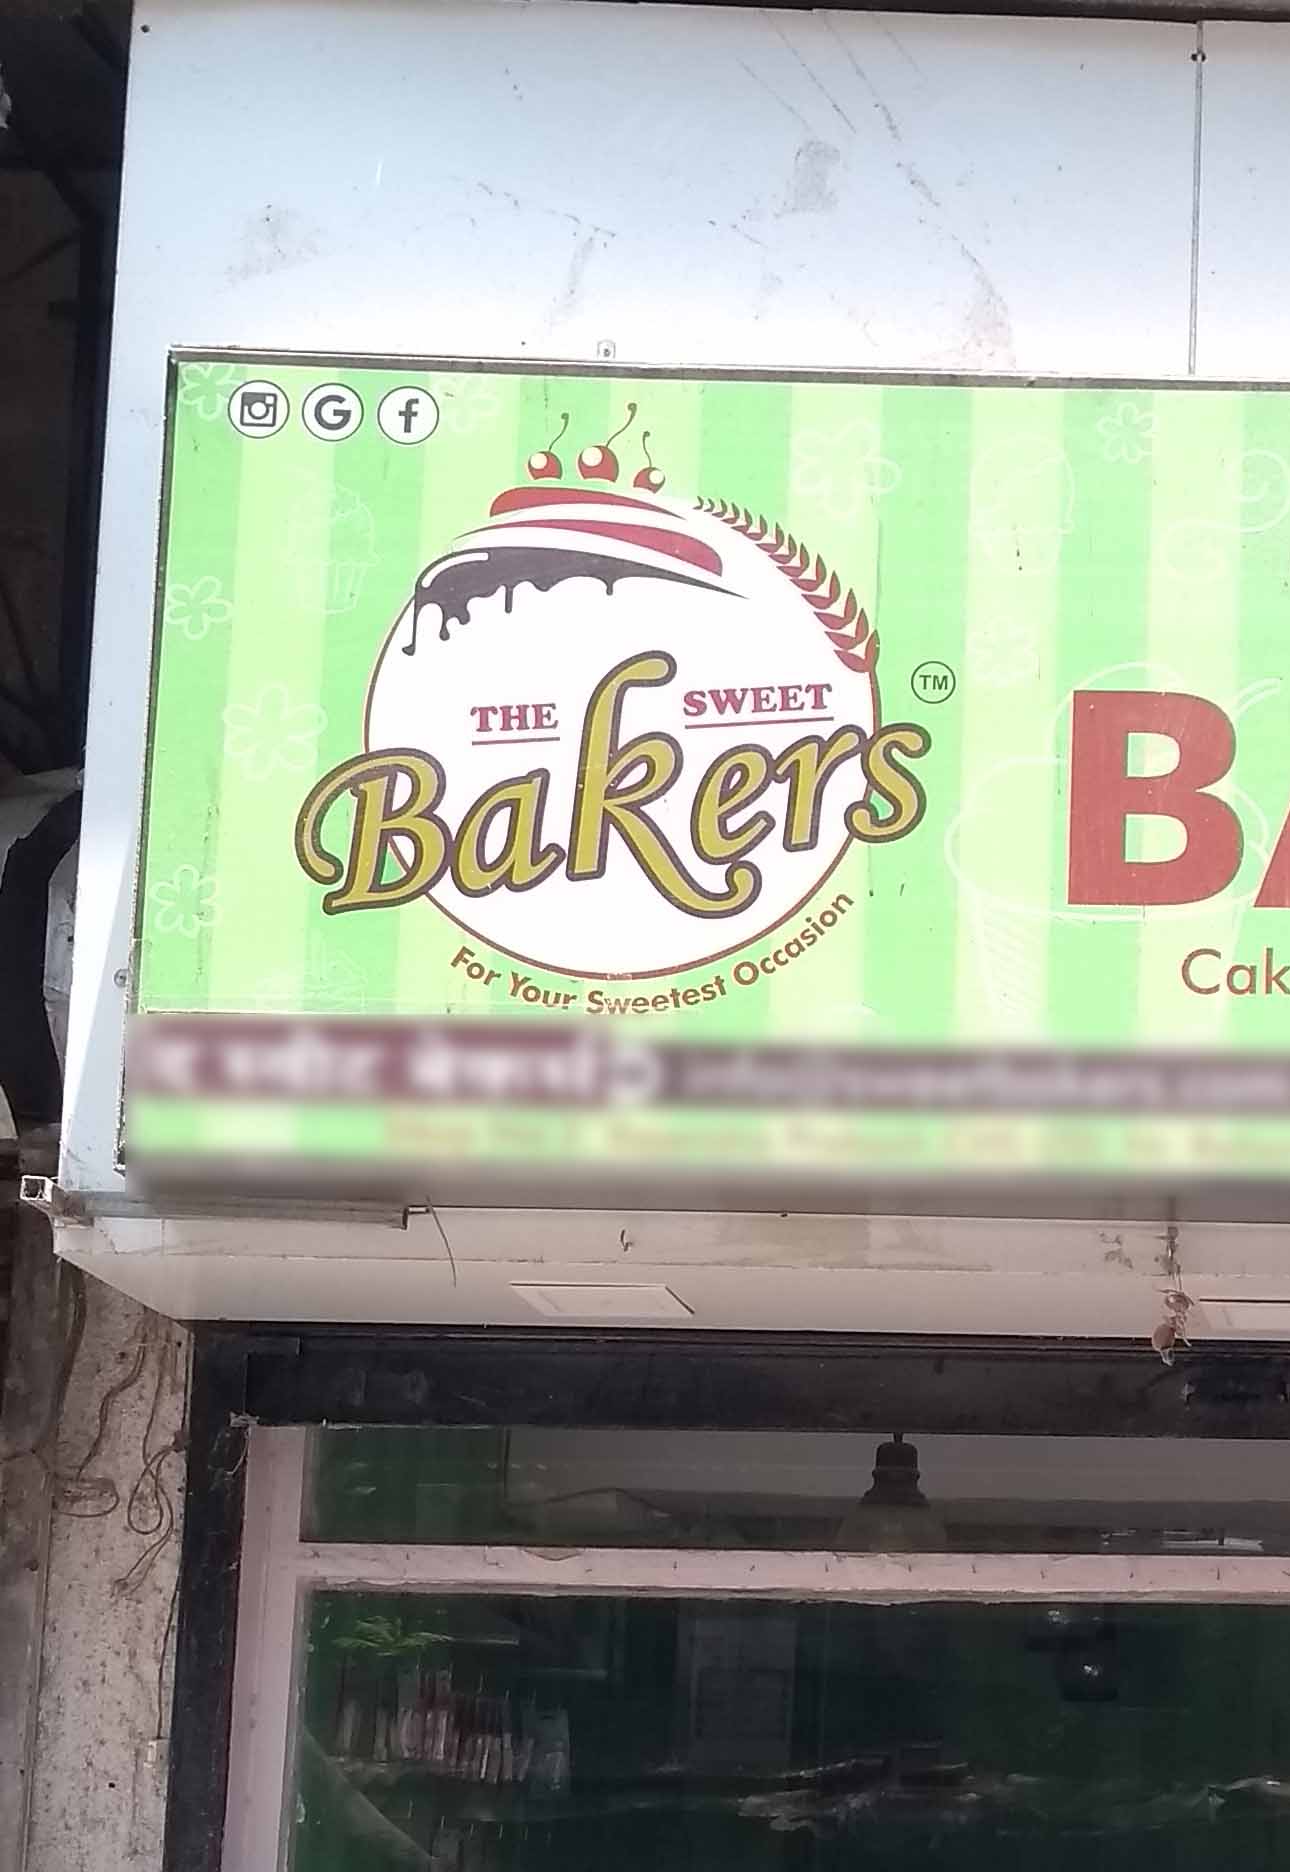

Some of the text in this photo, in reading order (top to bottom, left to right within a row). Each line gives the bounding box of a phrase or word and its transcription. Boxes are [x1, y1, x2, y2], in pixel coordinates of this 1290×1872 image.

[470, 683, 834, 733] THE SWEET
[295, 650, 932, 920] Bakers
[450, 889, 856, 1015] For Your Sweetest Occasion
